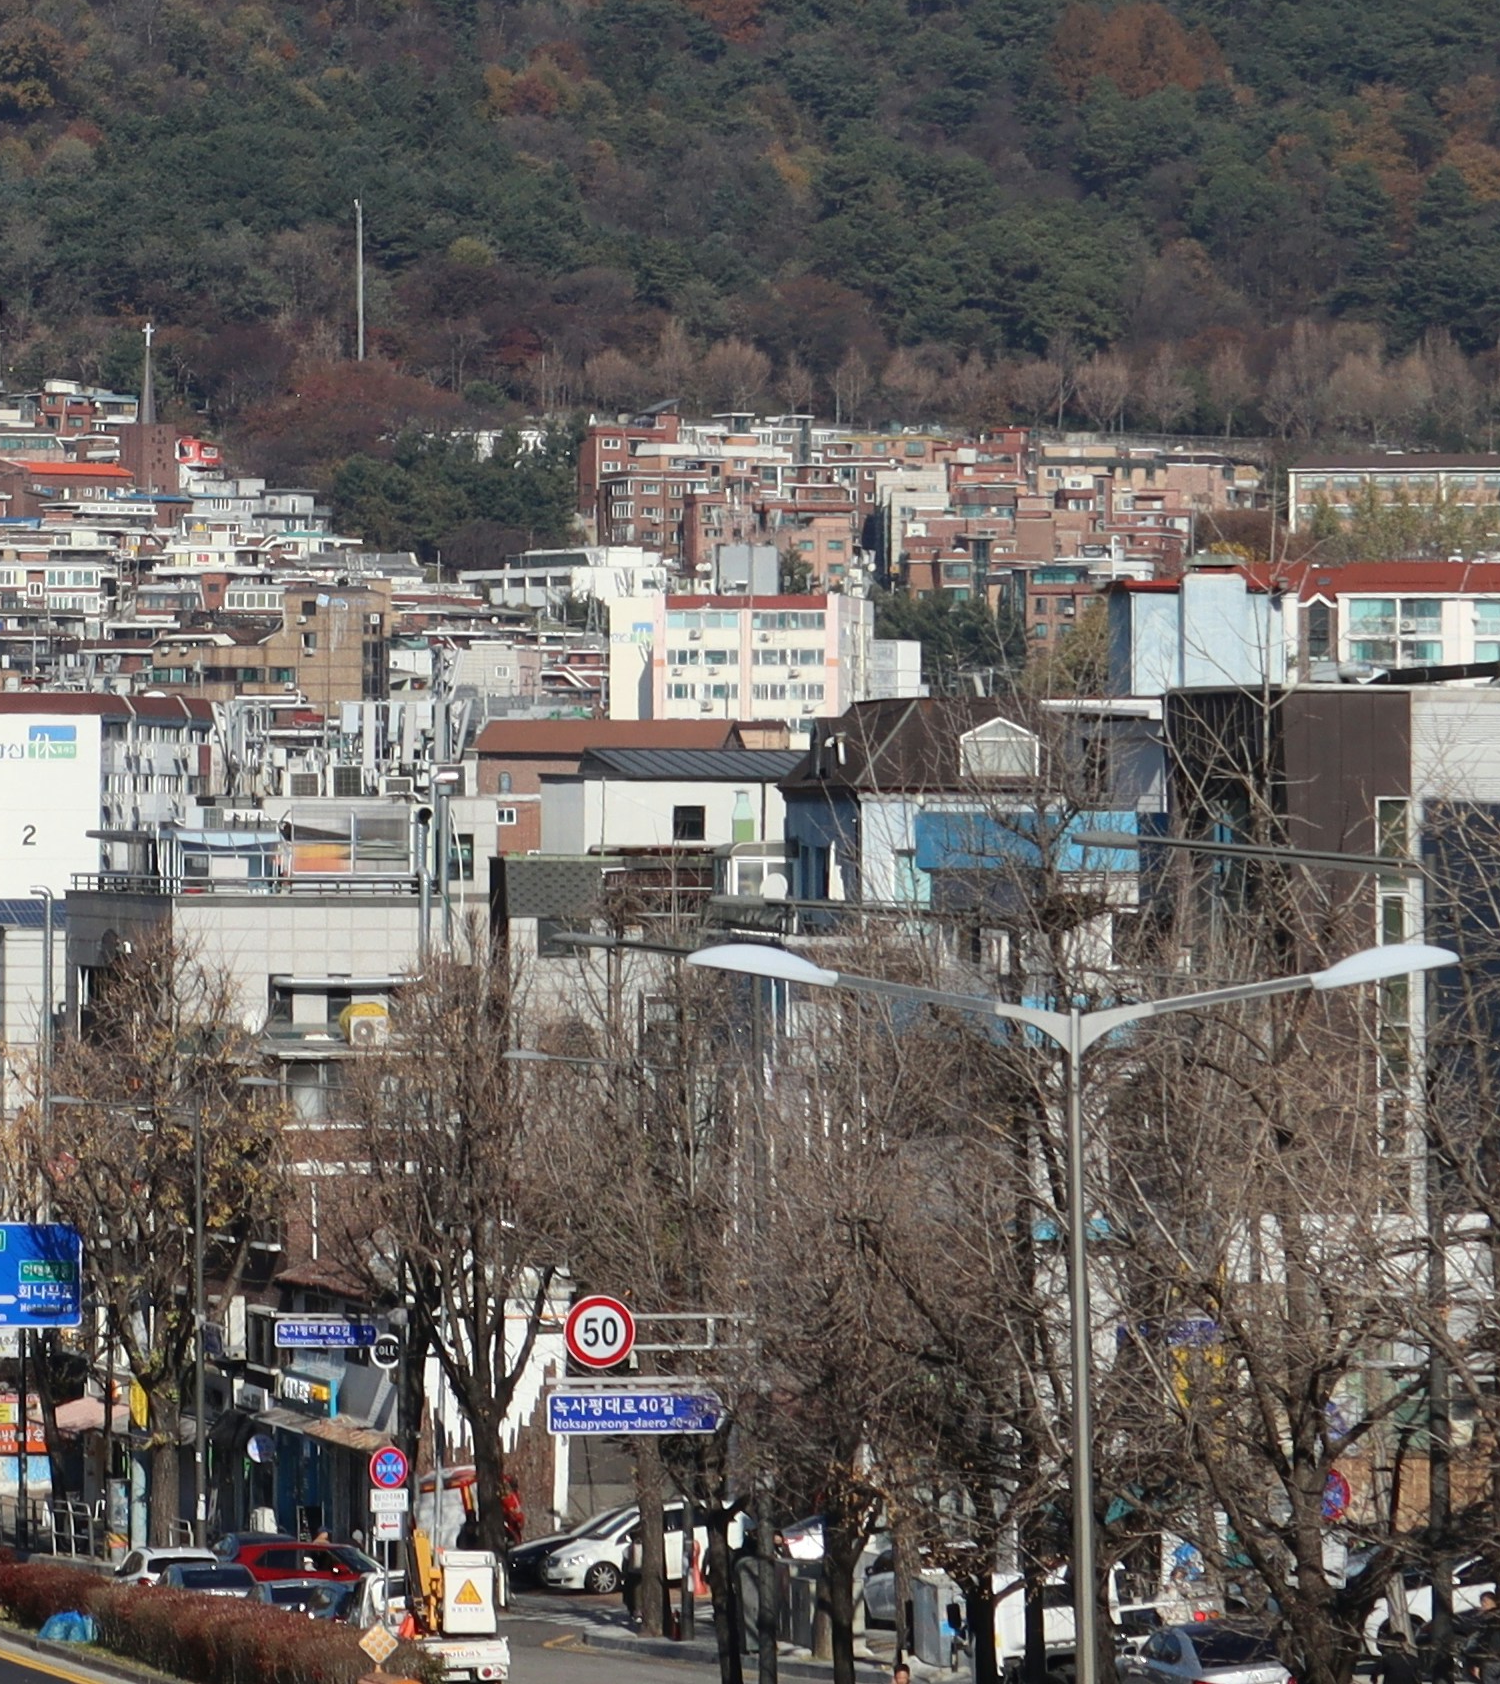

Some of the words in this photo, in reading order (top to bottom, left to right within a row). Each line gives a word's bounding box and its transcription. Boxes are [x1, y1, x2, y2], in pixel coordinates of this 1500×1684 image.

[31, 732, 57, 759] 休
[22, 824, 37, 846] 2
[18, 1284, 73, 1300] 회나무로
[279, 1324, 351, 1337] 녹사평대로42길
[583, 1317, 618, 1347] 50
[553, 1397, 675, 1416] 녹사평대로40길
[553, 1418, 668, 1431] Noksapyeong-daero
